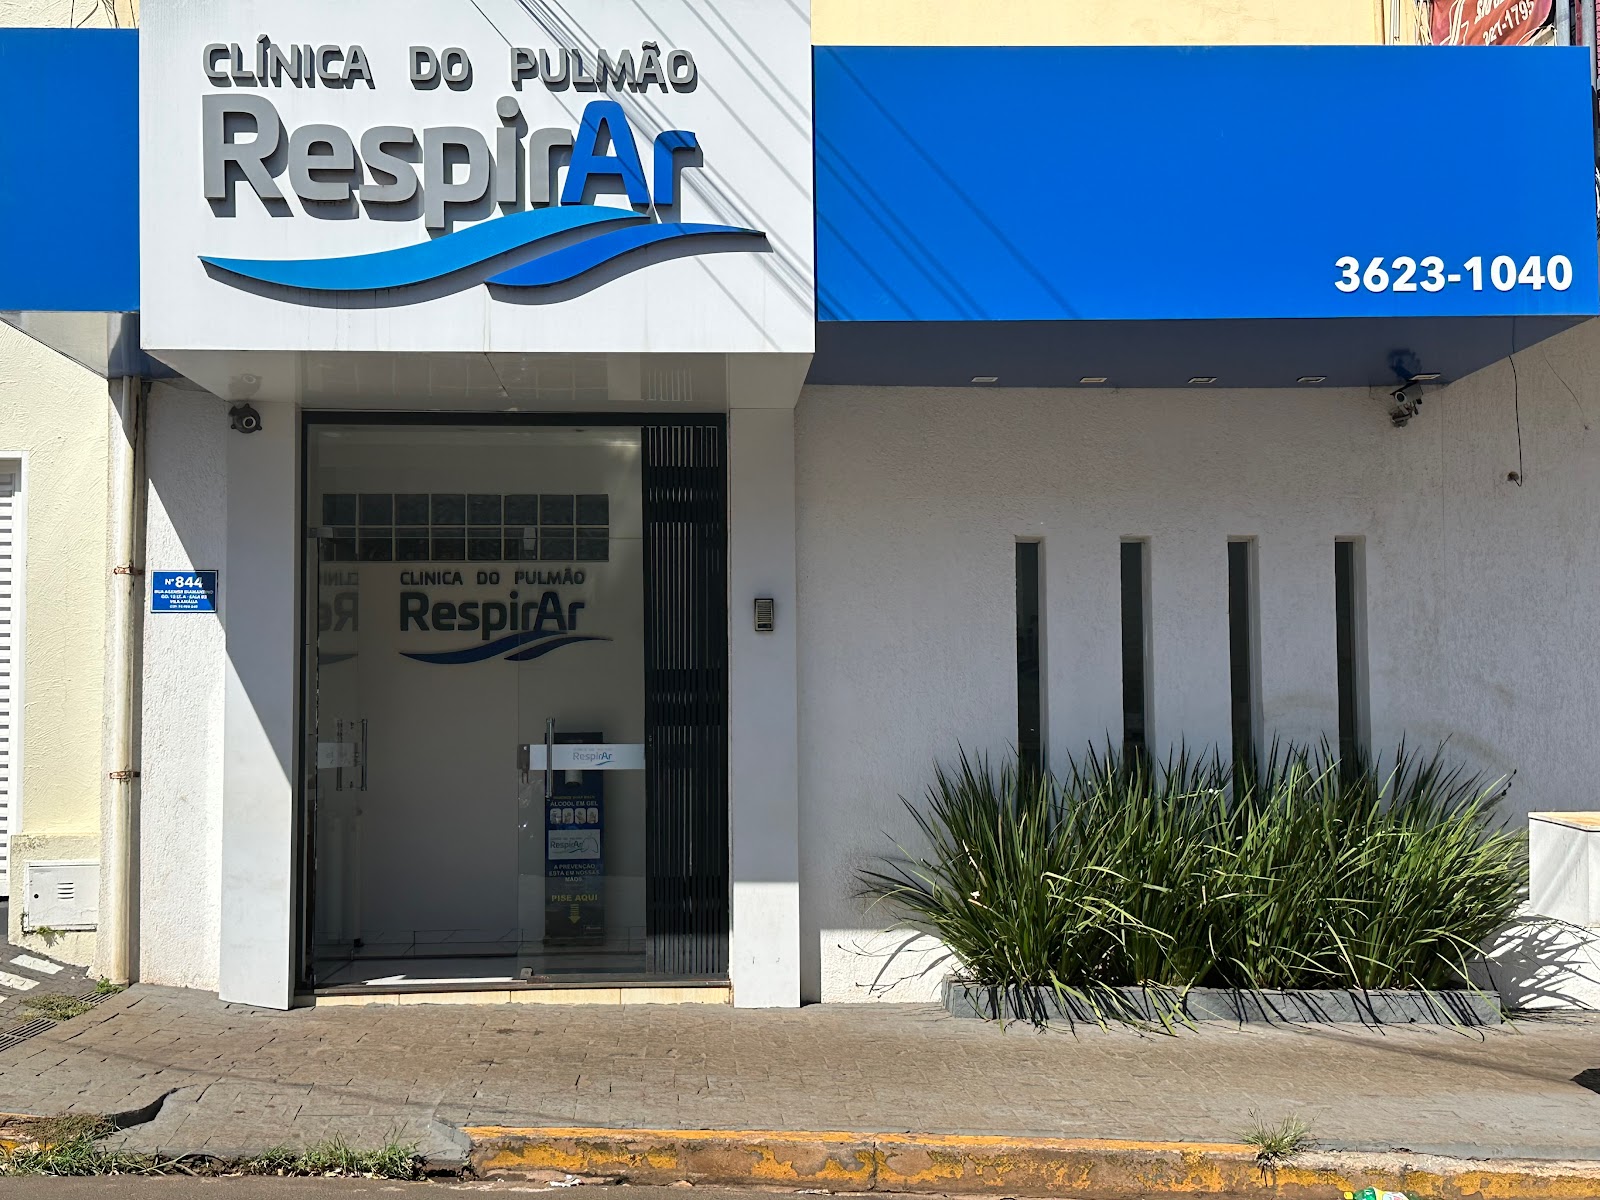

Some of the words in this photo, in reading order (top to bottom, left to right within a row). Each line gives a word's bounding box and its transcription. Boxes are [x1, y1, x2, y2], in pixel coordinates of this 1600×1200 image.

[202, 35, 373, 87] CLÍNICA
[409, 45, 472, 88] DO
[509, 41, 698, 92] PULMÃO
[202, 95, 700, 234] RespirAr
[1334, 254, 1573, 293] 3623-1040
[175, 575, 203, 588] 844
[477, 571, 500, 585] DO
[515, 568, 585, 585] PULMÃO
[400, 591, 585, 640] RespirAr
[573, 751, 613, 762] RespirAr
[551, 894, 573, 902] PISE
[575, 893, 598, 902] AQUI
